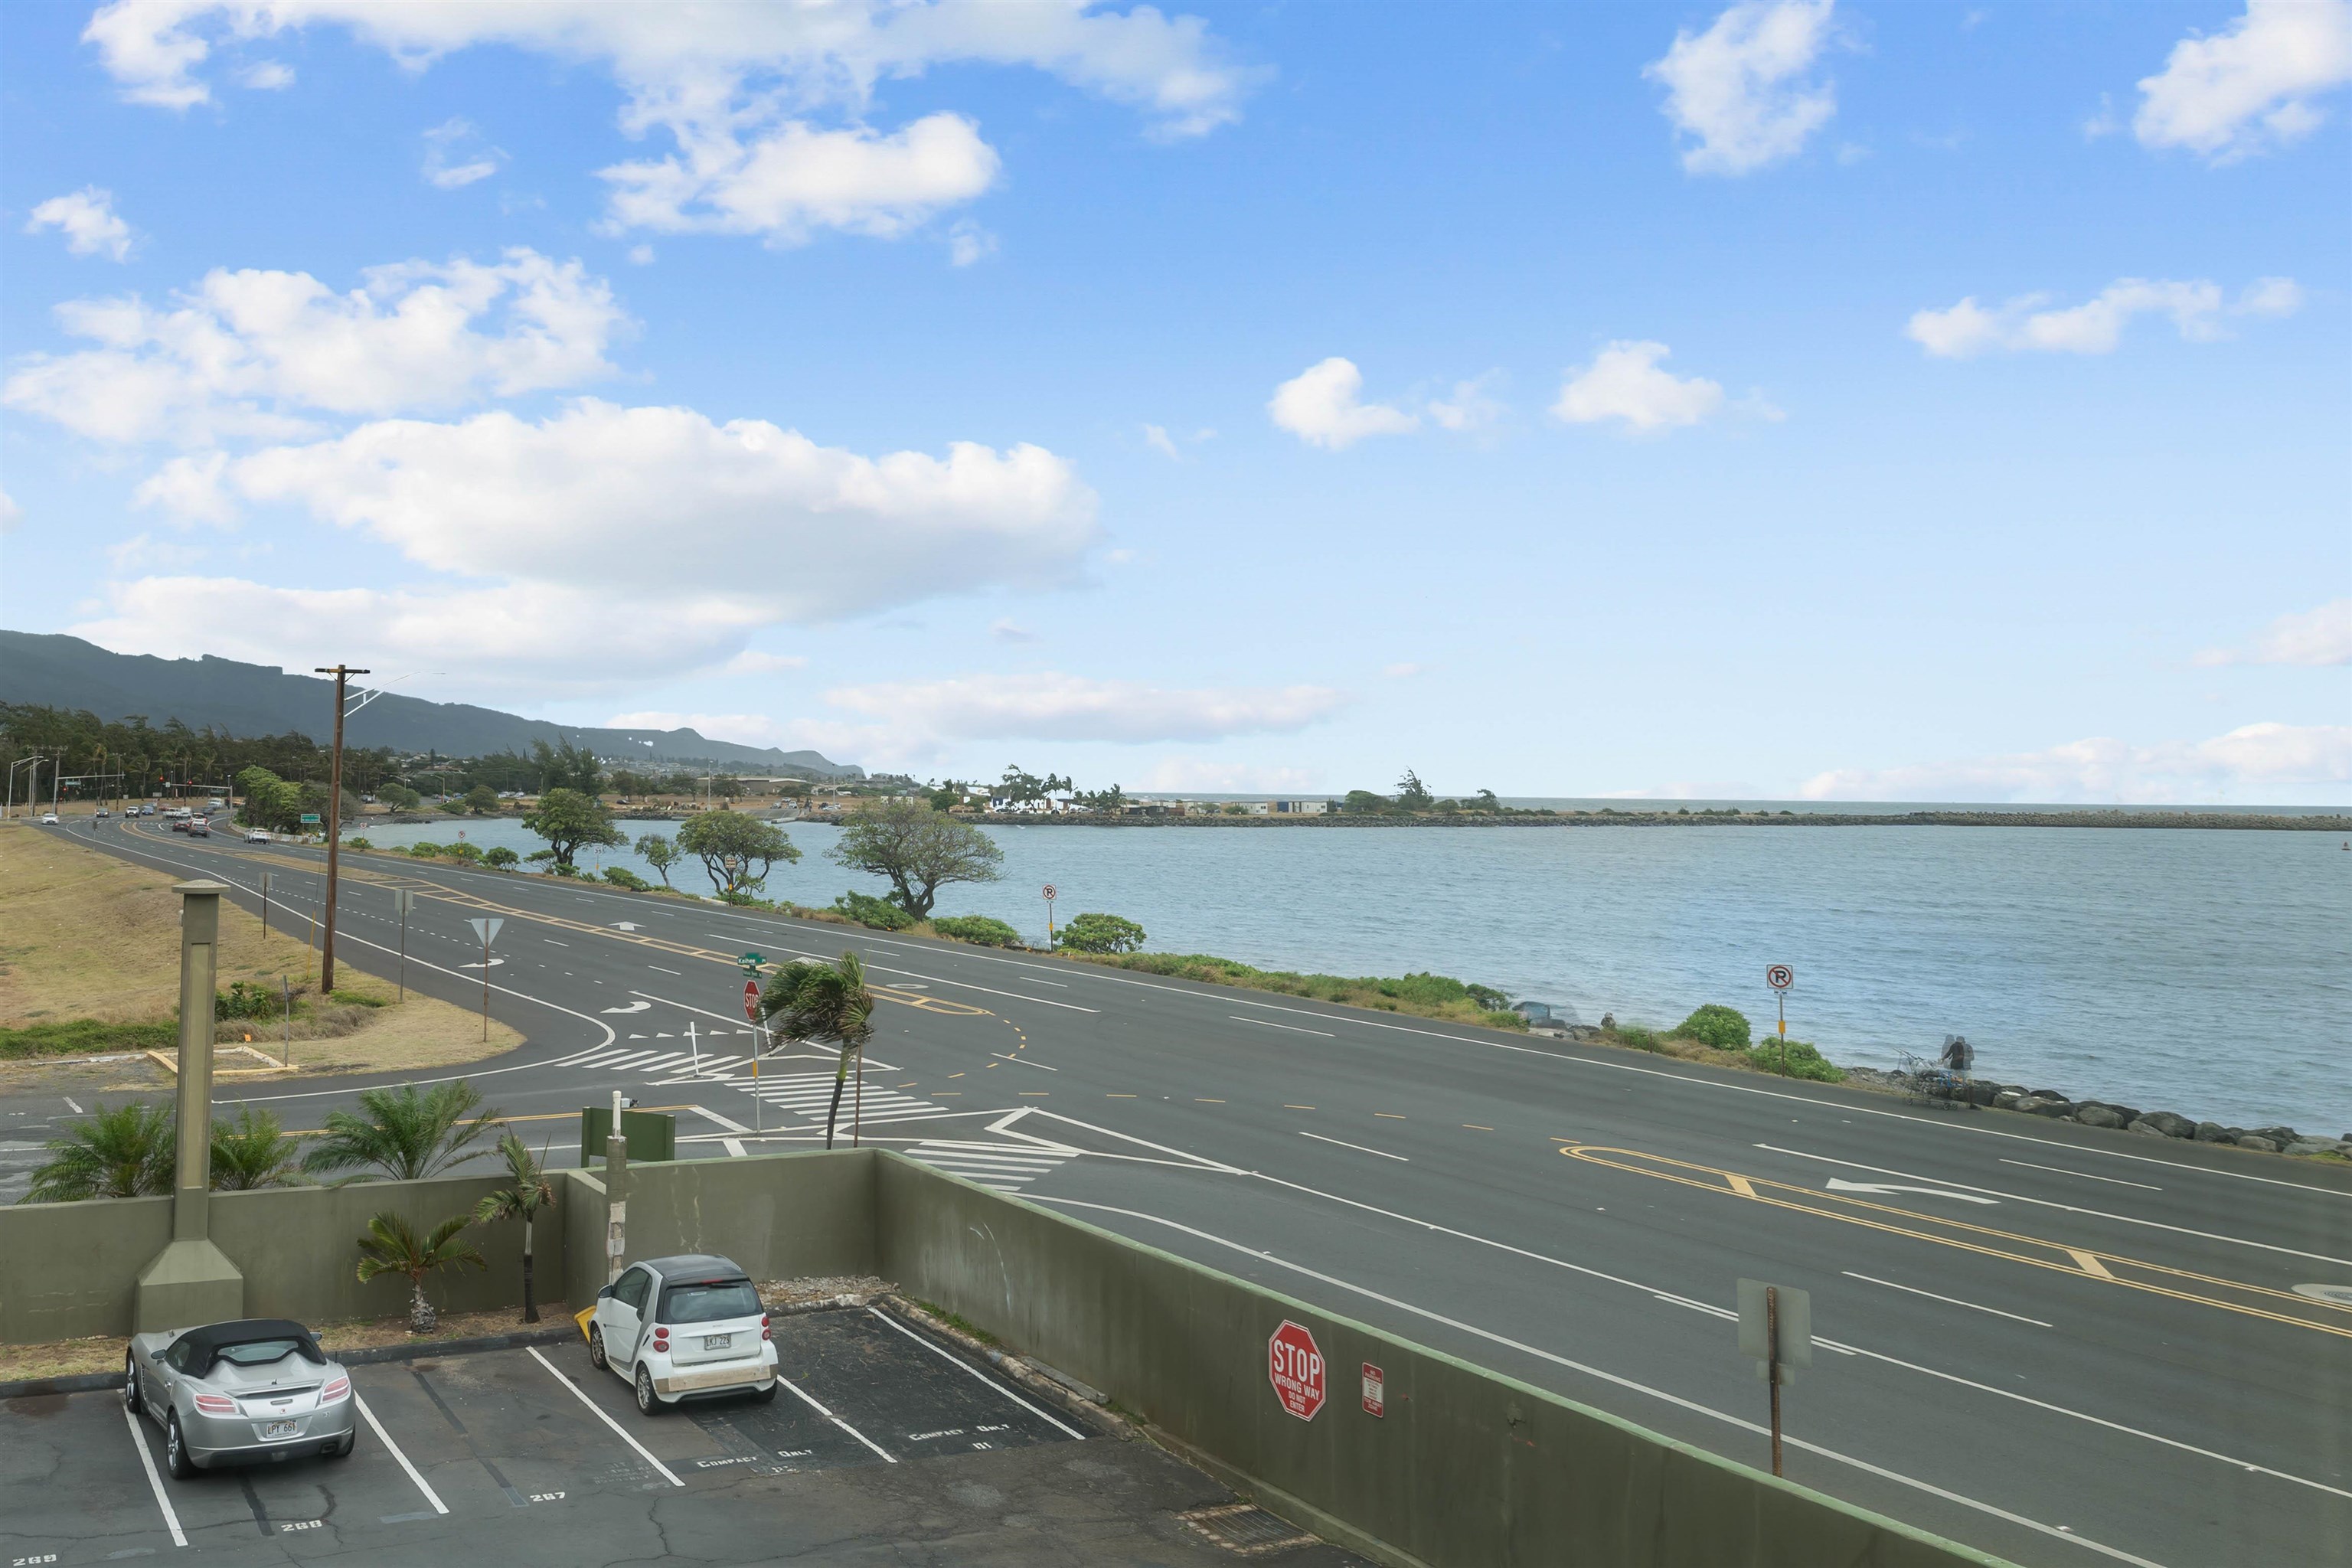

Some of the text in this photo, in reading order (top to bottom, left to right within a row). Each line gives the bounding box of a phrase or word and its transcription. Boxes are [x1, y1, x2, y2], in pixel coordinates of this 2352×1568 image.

[745, 993, 759, 1008] STOP
[1274, 1339, 1320, 1386] STOP
[1274, 1371, 1320, 1401] WRONG WAY
[1289, 1390, 1306, 1405] DO NOT
[1289, 1400, 1305, 1413] ENTER
[267, 1423, 296, 1435] LPY 661
[530, 1491, 566, 1501] 267
[281, 1520, 322, 1532] 268
[12, 1553, 57, 1566] 269
